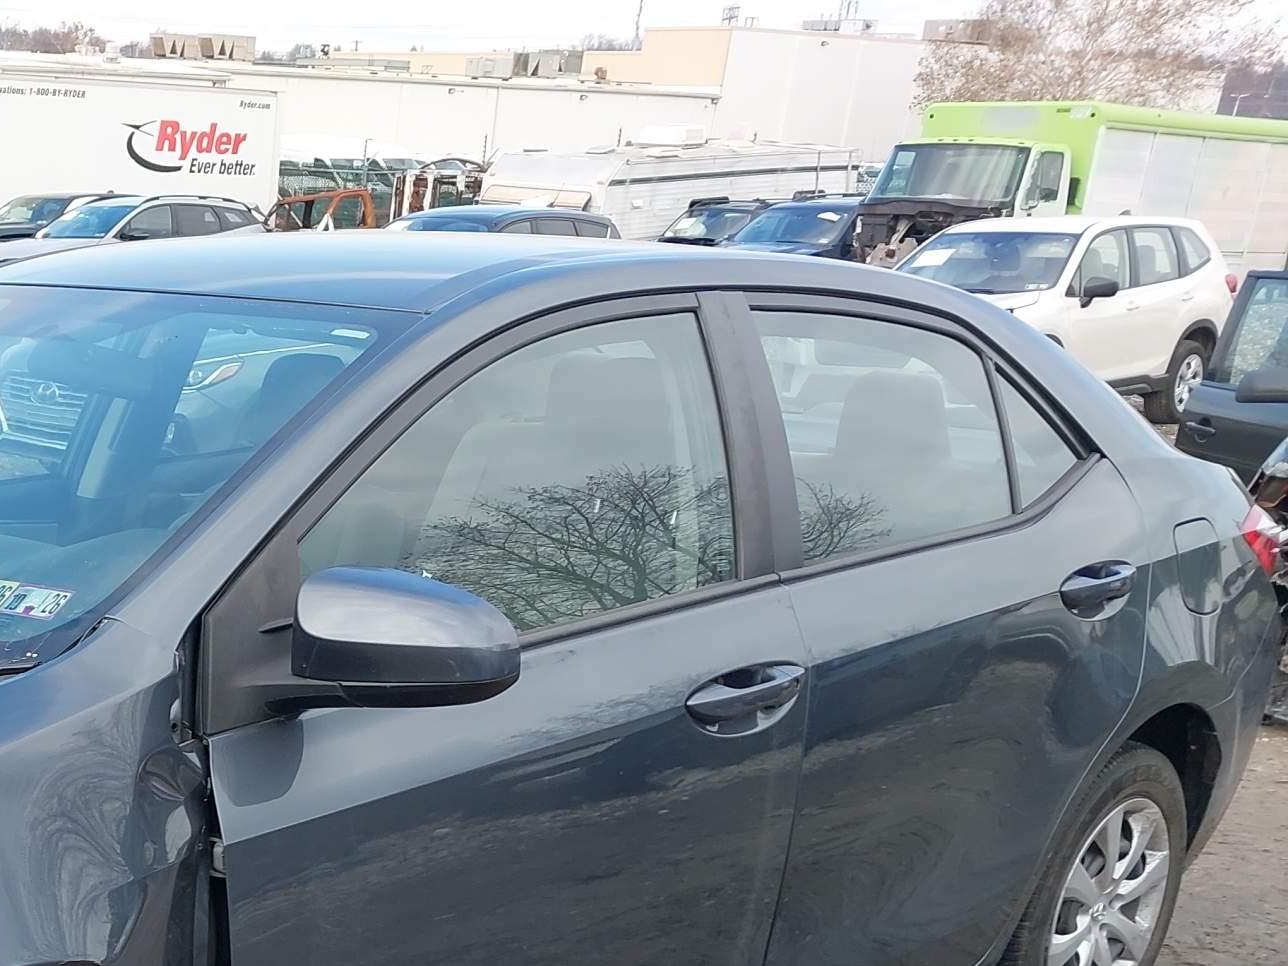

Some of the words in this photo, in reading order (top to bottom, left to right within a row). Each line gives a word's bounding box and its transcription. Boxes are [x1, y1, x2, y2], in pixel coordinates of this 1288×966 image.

[239, 99, 271, 110] Ryder.com
[155, 119, 248, 161] Ryder
[188, 157, 217, 174] Ever
[218, 158, 256, 176] better.
[40, 592, 68, 615] 26
